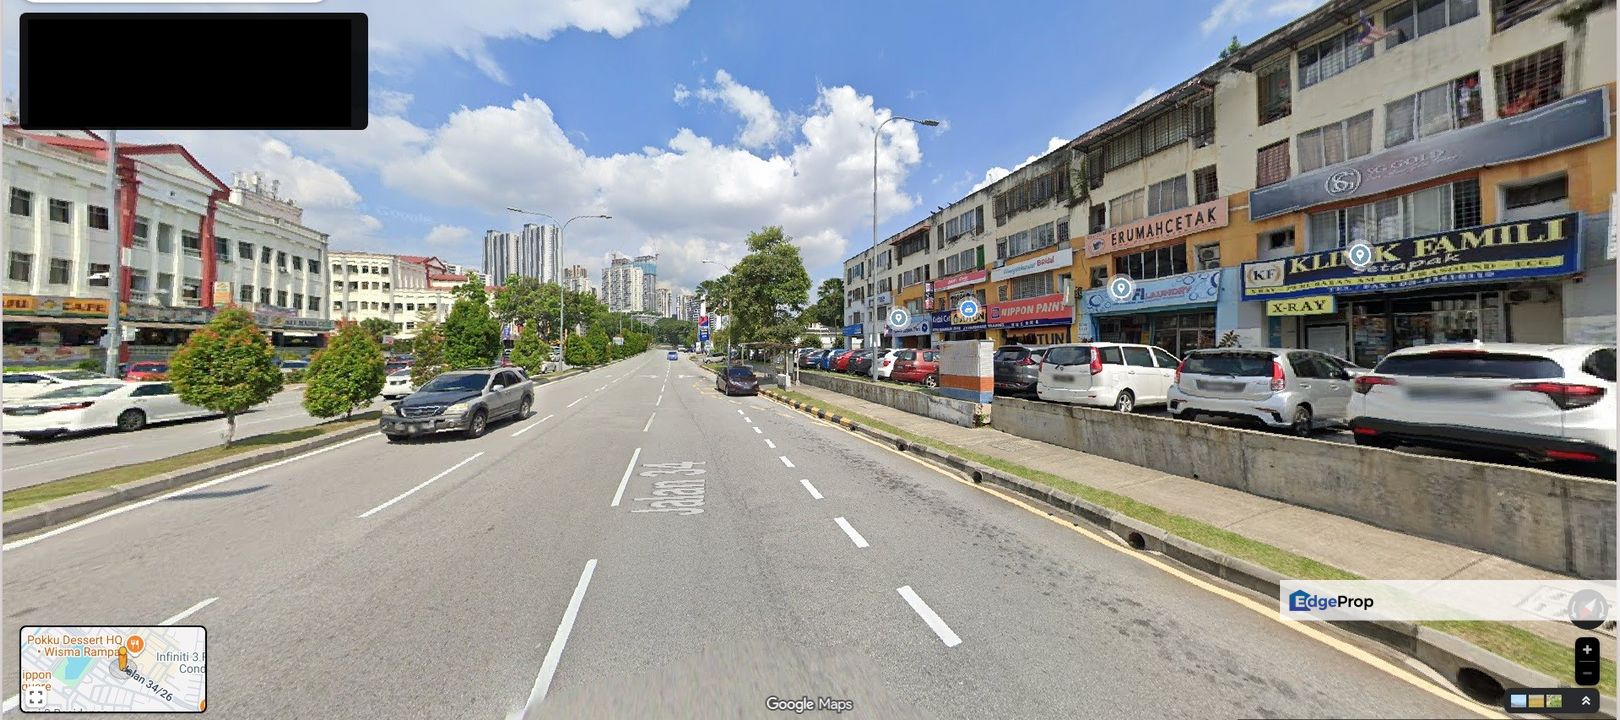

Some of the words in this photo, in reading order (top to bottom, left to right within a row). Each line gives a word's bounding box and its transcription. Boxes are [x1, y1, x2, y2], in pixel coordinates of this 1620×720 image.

[1111, 206, 1217, 247] ERUMAHCETAK
[1288, 242, 1401, 274] KLIK
[1252, 268, 1276, 281] KF
[1145, 286, 1192, 299] LAUNDRY
[1001, 305, 1035, 318] NIPPON
[1035, 301, 1065, 314] PAINT
[1272, 300, 1326, 313] X-RAY
